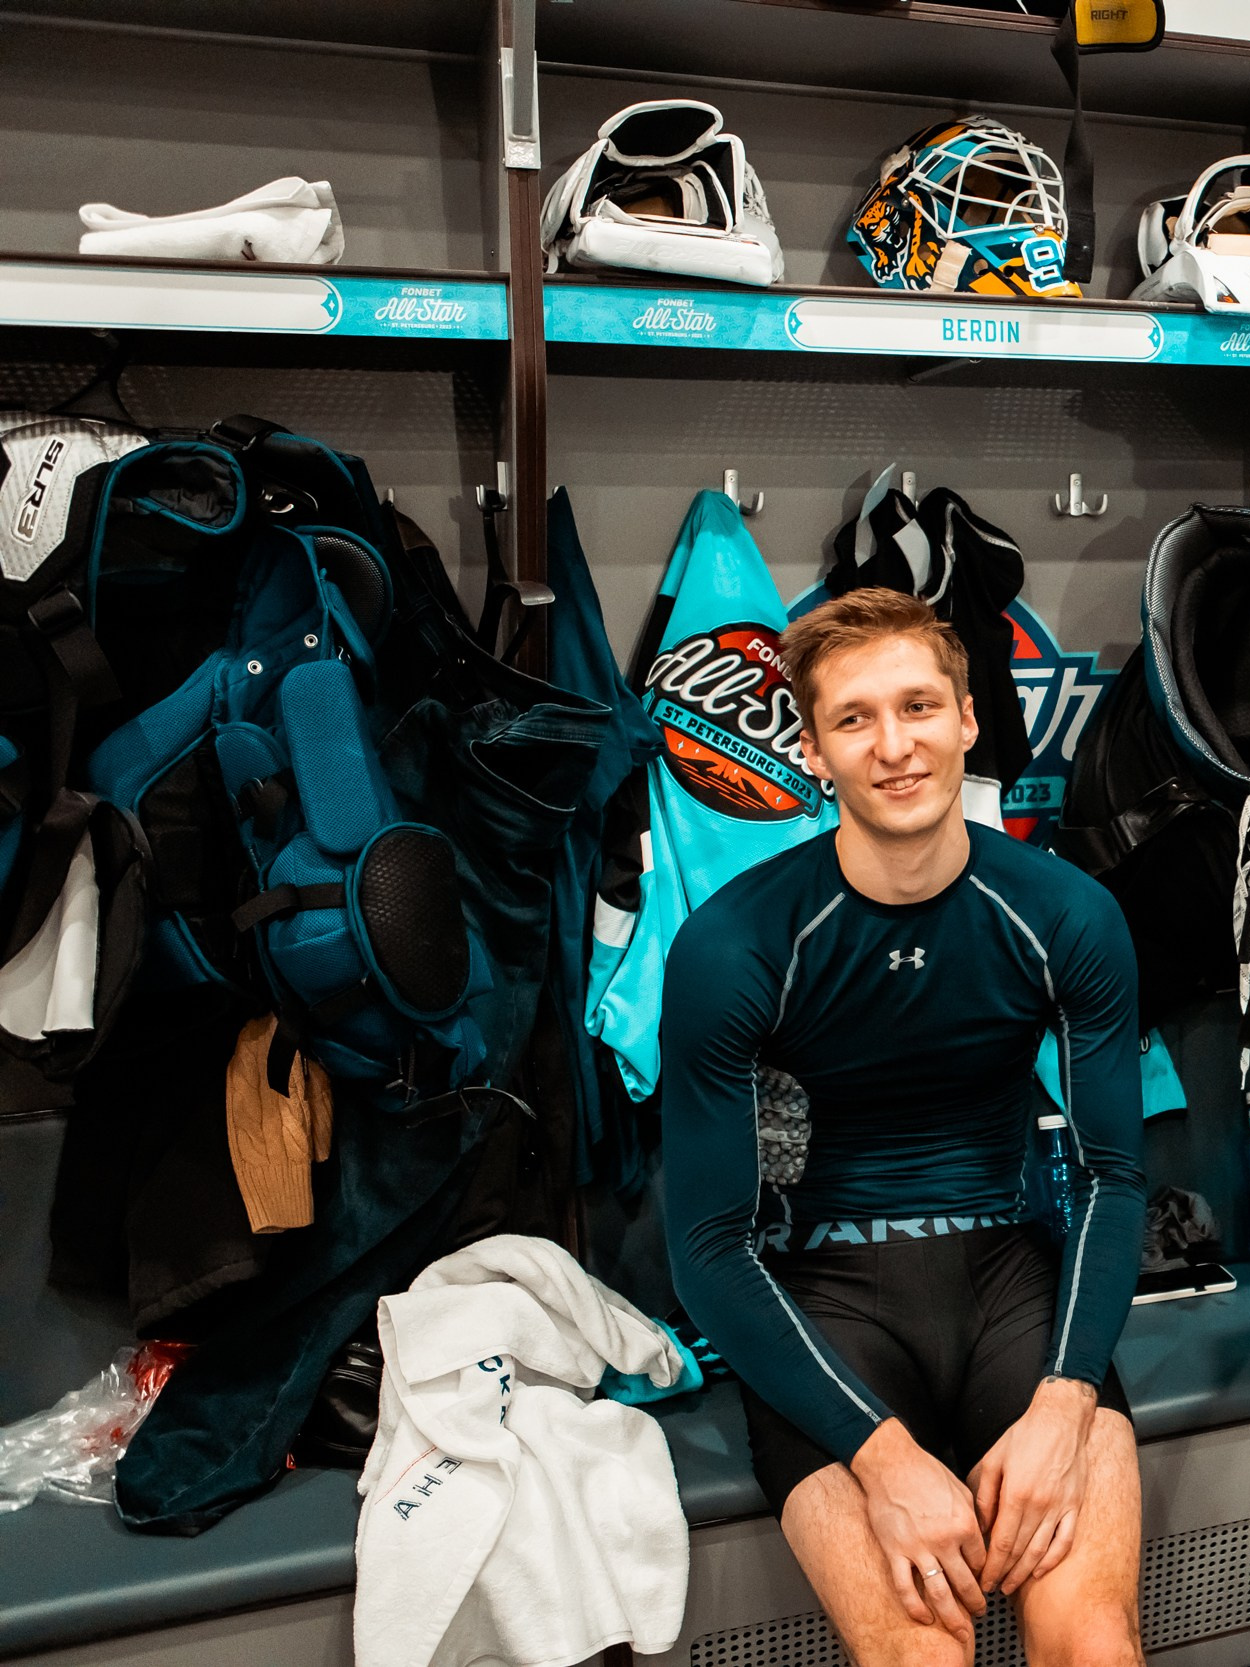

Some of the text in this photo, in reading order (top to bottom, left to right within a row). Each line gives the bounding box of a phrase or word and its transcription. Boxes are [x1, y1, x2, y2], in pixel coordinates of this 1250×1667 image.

[1090, 10, 1128, 20] RIGHT
[401, 287, 442, 297] FONBET
[657, 298, 695, 307] FONBET
[374, 297, 467, 322] All-Star
[632, 307, 717, 332] All-Star
[942, 318, 1020, 343] BERDIN
[663, 705, 813, 799] ST. PETERSBURG 2023
